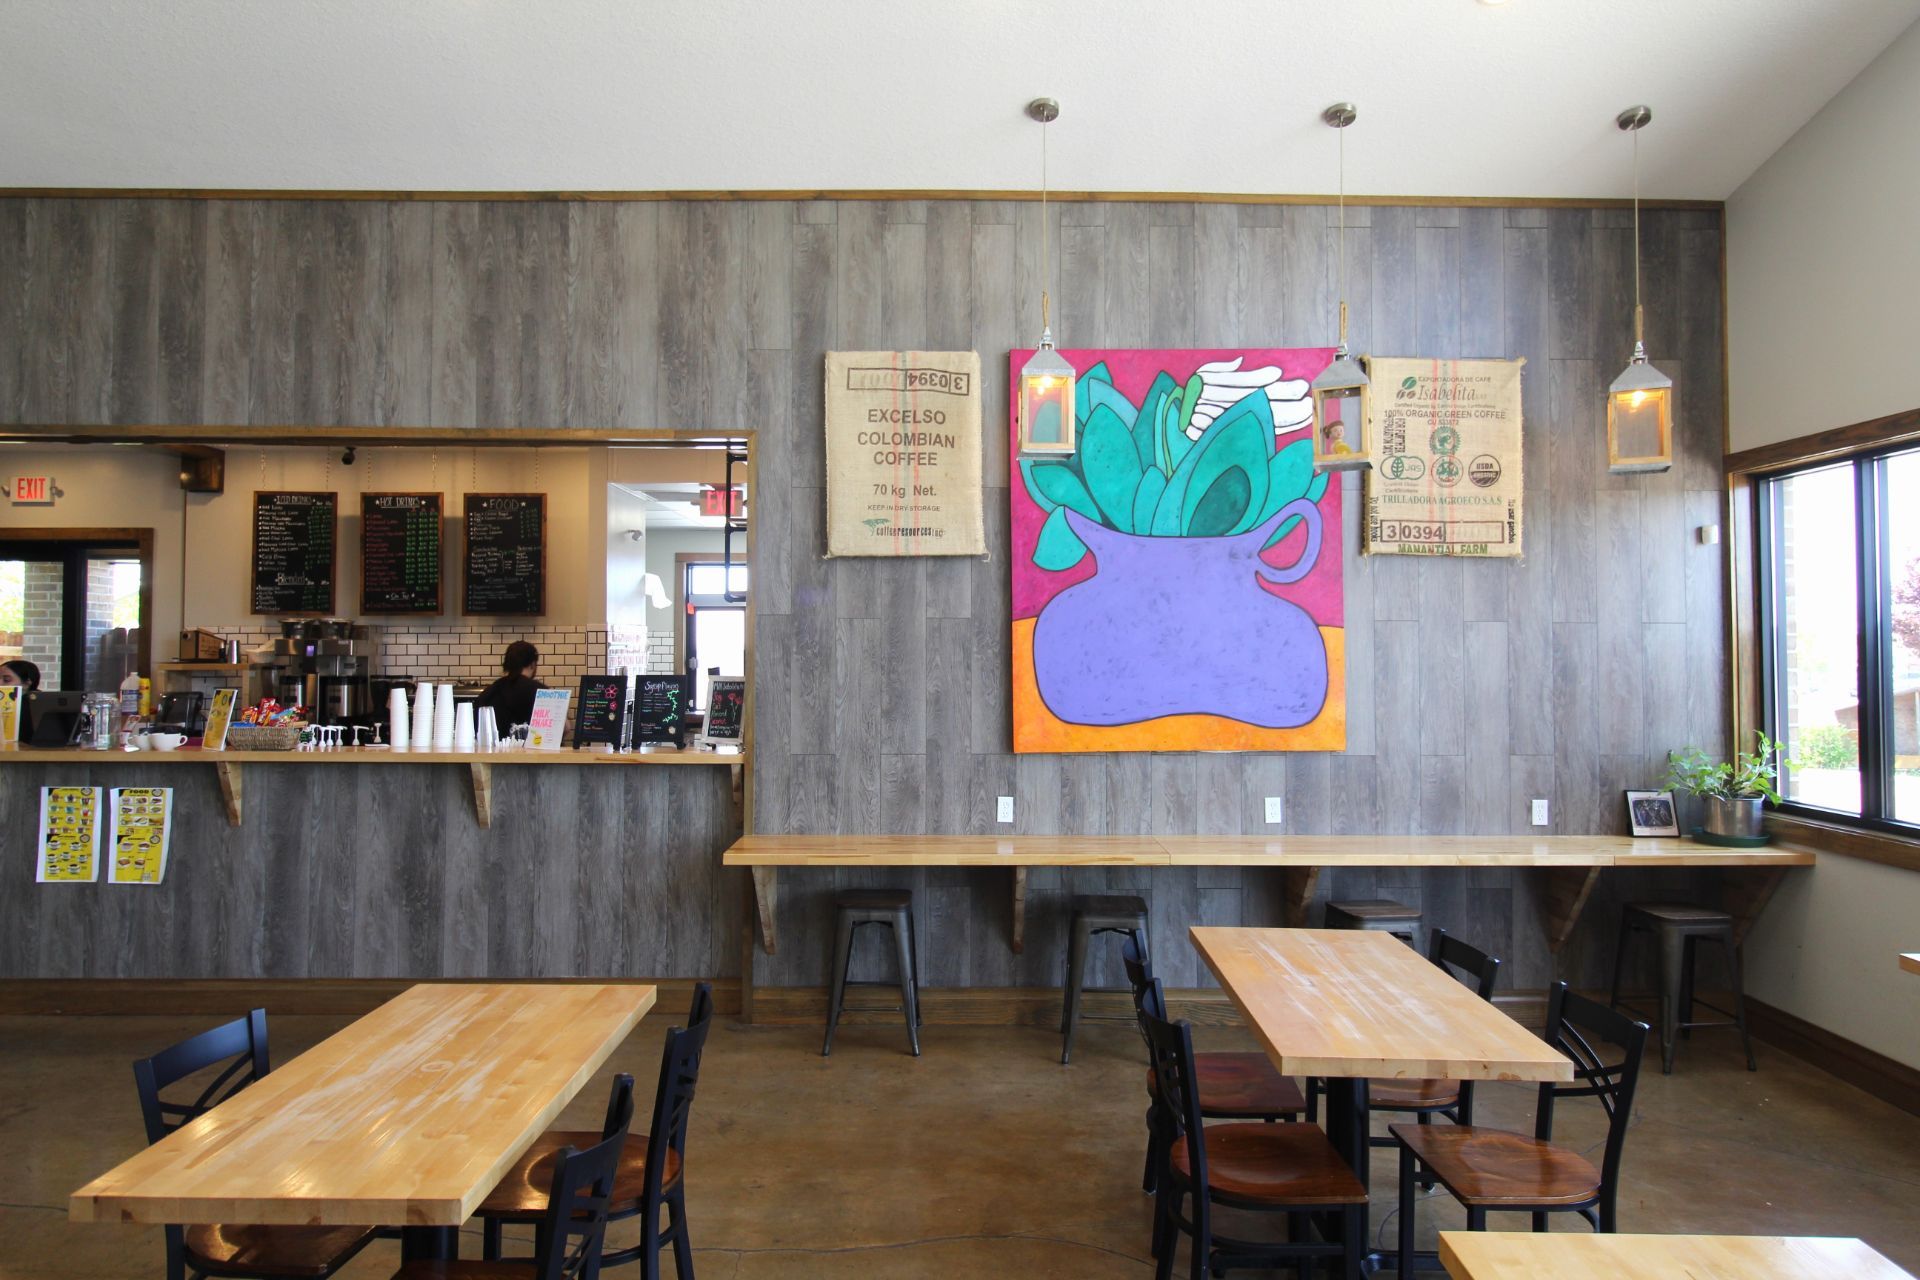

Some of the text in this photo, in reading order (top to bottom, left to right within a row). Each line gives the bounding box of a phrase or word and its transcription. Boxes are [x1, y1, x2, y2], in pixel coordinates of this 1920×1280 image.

[907, 372, 949, 388] 0394
[1417, 383, 1476, 401] Isabelita
[867, 408, 946, 425] EXCELSO
[1405, 409, 1444, 418] ORGANIC
[1444, 410, 1472, 419] GREEN
[1473, 410, 1507, 420] COFFEE
[857, 431, 955, 449] COLOMBIAN
[873, 451, 938, 466] COFFEE
[1476, 462, 1494, 470] USDA
[17, 477, 46, 500] EXIT
[873, 484, 937, 499] 70 kg Net.
[395, 496, 421, 508] DRINKS
[489, 499, 519, 510] FOOD
[706, 490, 738, 515] EXT
[1382, 494, 1437, 505] TRILLADORA
[1439, 495, 1481, 505] AGROECO
[1387, 525, 1397, 539] 3
[1402, 525, 1443, 540] 0394
[1397, 543, 1488, 555] MANANTIAL FARM
[533, 708, 551, 718] MILK
